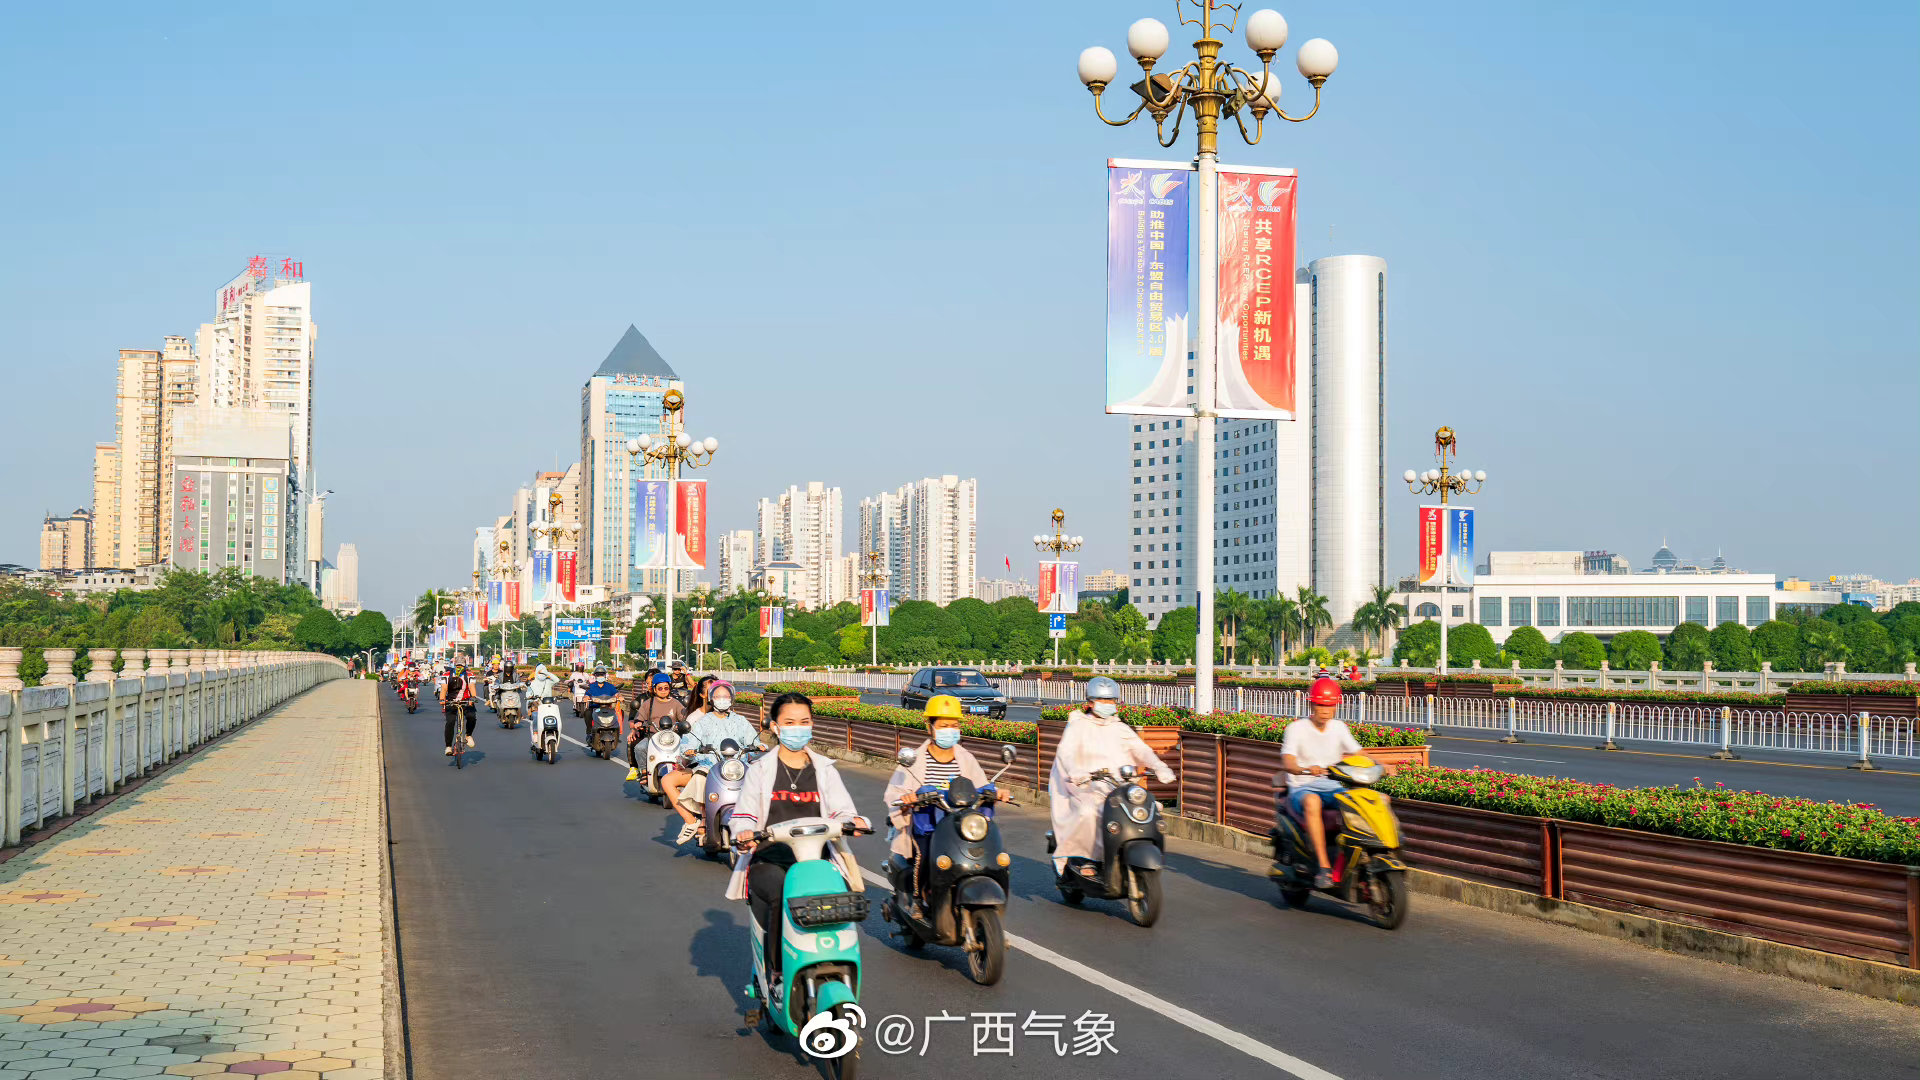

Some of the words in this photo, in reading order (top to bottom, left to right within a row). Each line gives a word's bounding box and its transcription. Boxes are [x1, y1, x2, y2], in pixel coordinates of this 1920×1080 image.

[1136, 210, 1145, 239] Building
[1241, 218, 1250, 252] Sharing
[246, 255, 304, 279] 嘉和
[1136, 247, 1145, 273] Version
[1242, 254, 1250, 280] RCEP
[1253, 218, 1273, 361] 共享RCEP新机遇
[1241, 303, 1250, 361] Opportunities
